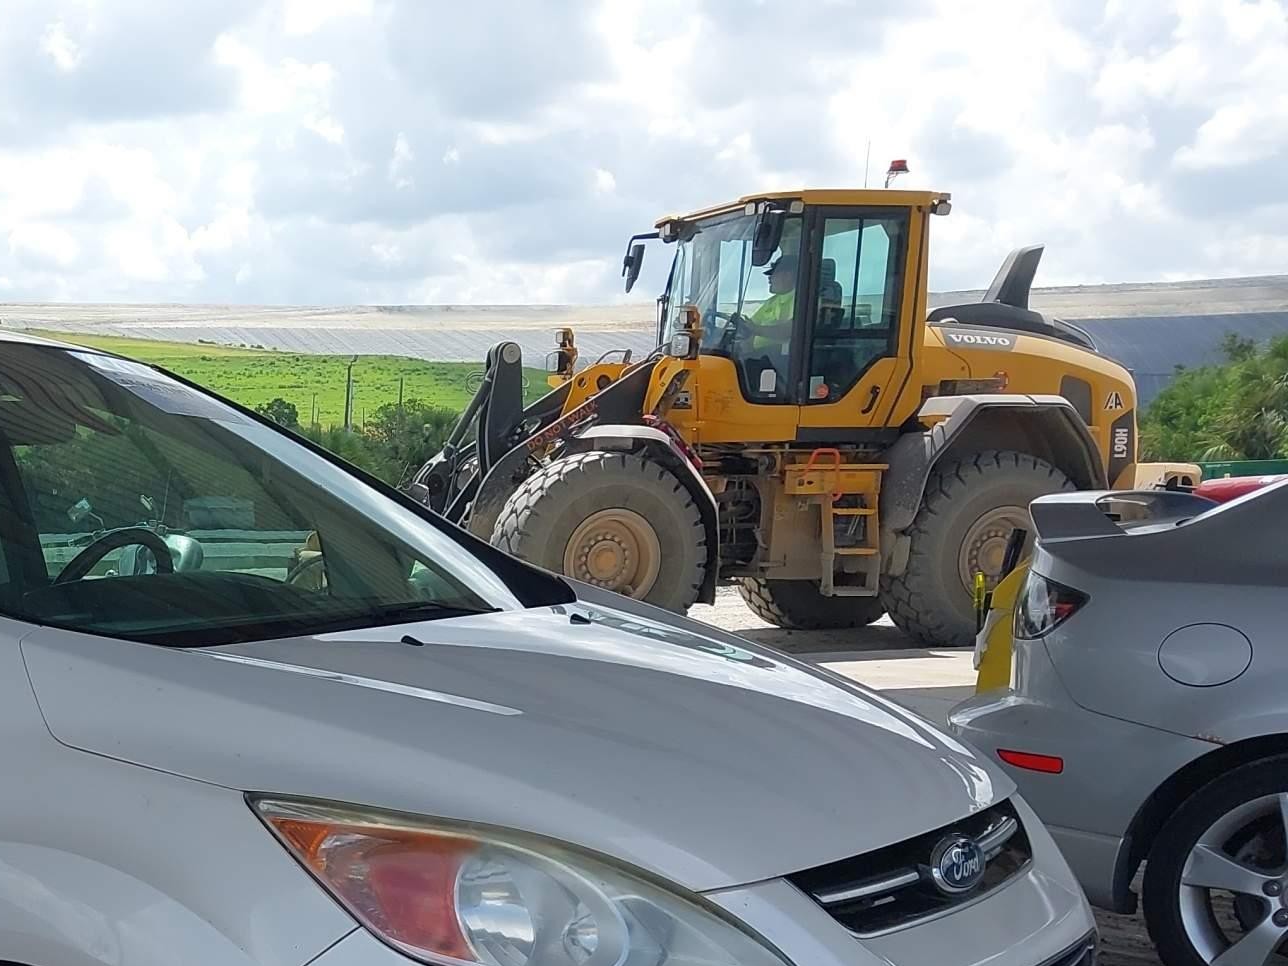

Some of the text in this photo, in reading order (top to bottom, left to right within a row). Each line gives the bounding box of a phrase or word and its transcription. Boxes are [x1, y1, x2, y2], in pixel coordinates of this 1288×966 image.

[948, 334, 1011, 346] VOLVO
[1113, 428, 1129, 459] L90H
[951, 846, 980, 881] Ford
